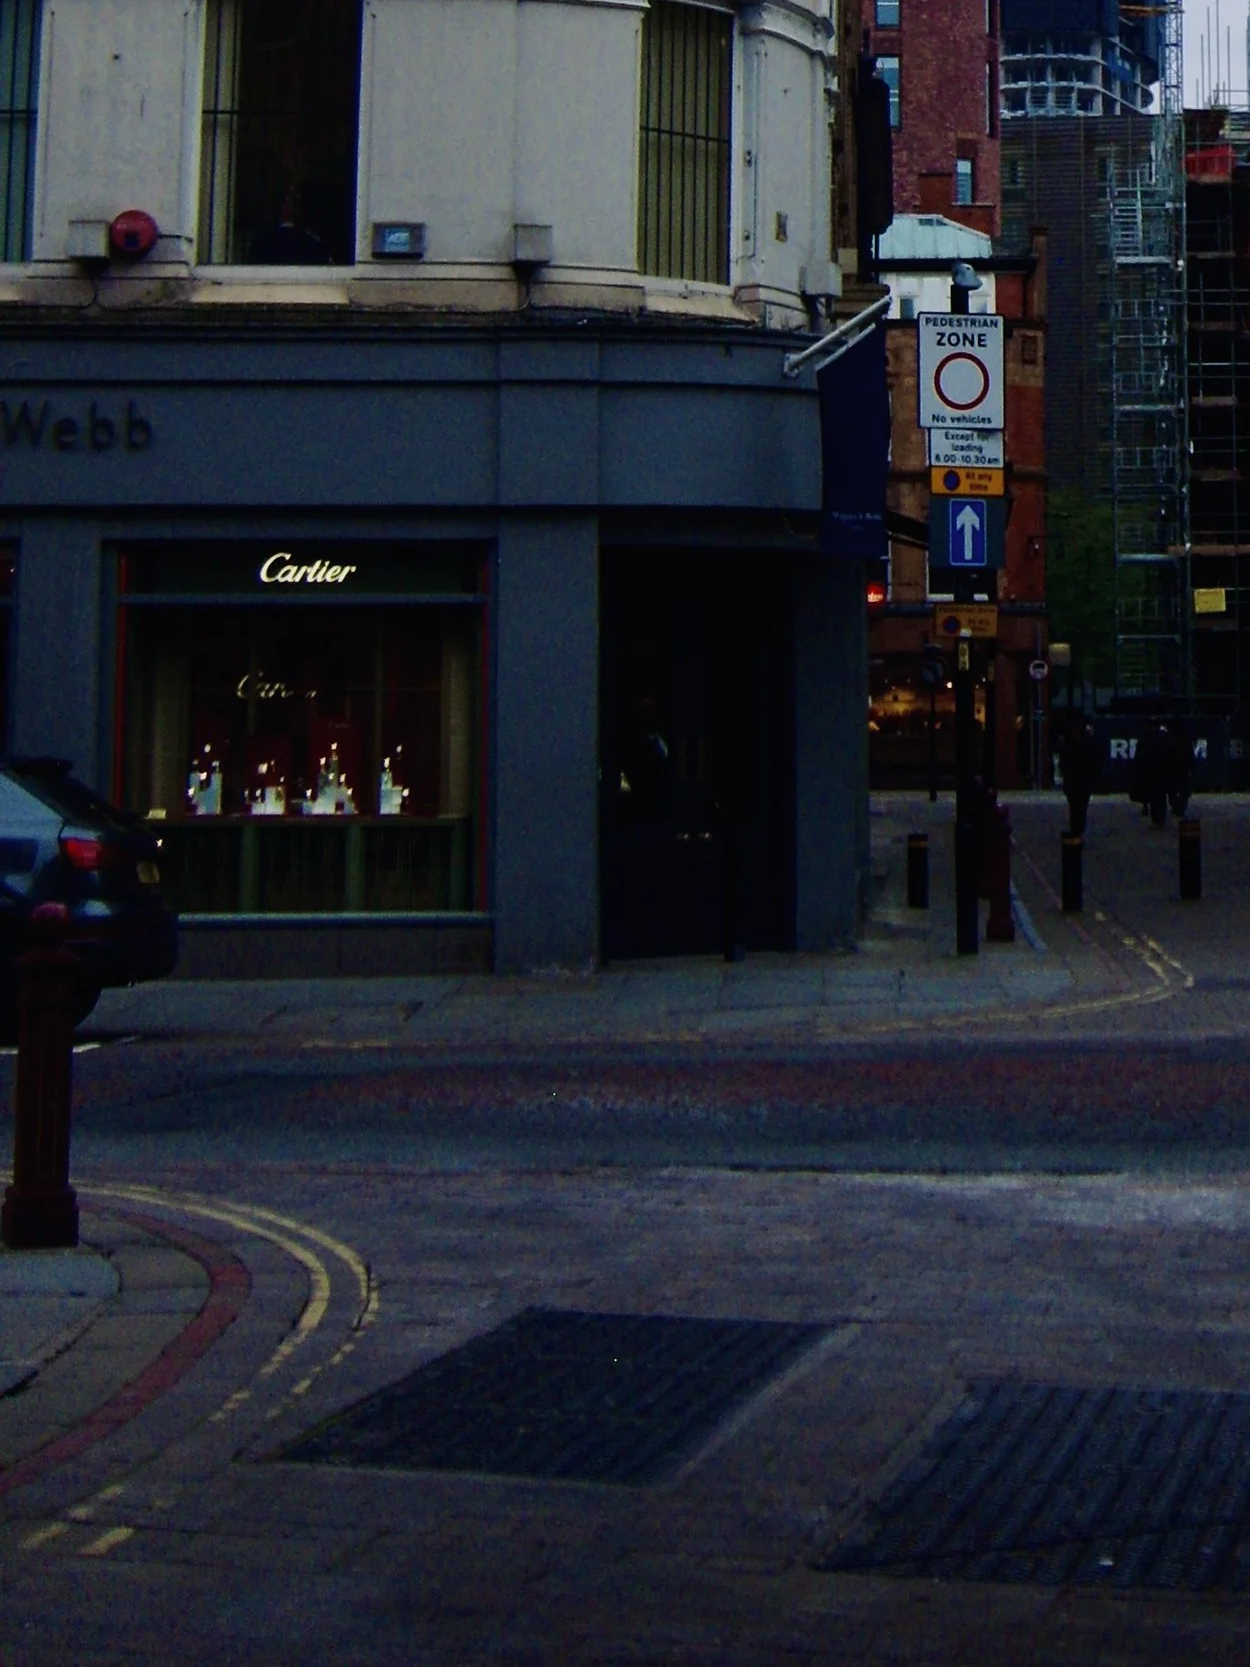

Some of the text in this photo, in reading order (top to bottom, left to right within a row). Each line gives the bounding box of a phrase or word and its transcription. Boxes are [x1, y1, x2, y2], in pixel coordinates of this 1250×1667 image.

[925, 317, 998, 328] PEDESTRIAN
[936, 332, 987, 347] ZONE
[932, 414, 992, 424] No vehicles
[0, 400, 152, 451] Webb
[944, 431, 975, 441] Except
[952, 443, 983, 454] loading
[259, 552, 357, 583] Cartier
